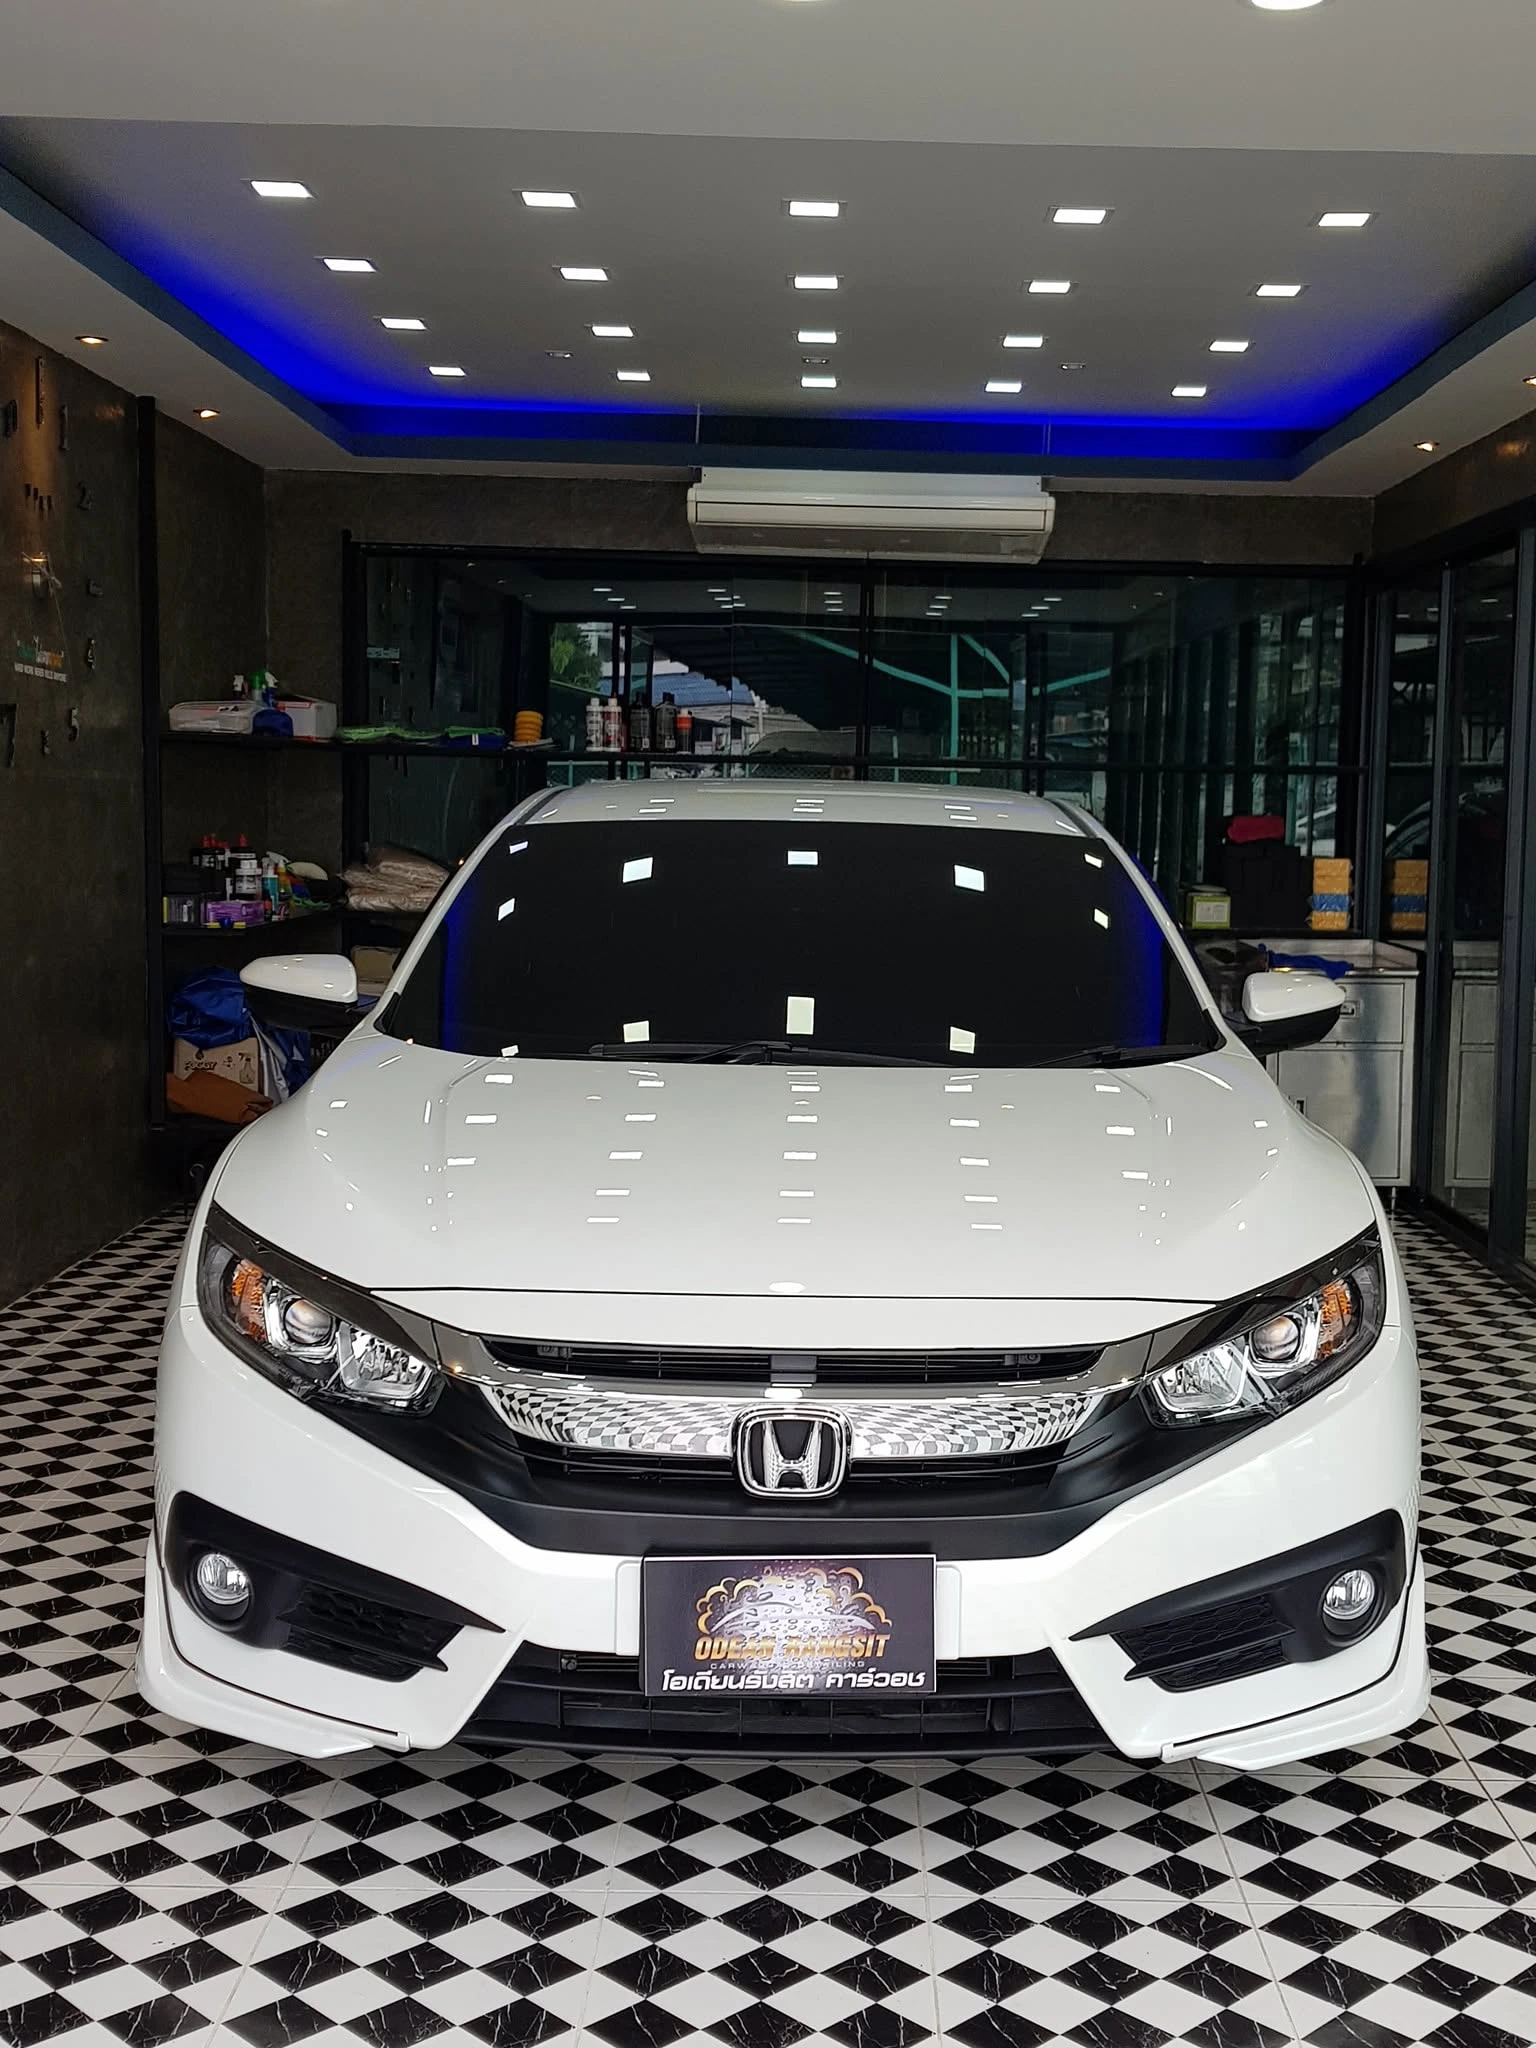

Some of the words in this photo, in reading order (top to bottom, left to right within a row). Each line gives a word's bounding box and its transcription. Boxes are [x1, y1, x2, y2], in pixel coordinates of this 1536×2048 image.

[694, 1635, 776, 1661] ODEAN
[784, 1633, 890, 1658] RANGSIT
[662, 1669, 815, 1691] โอเดียนรังสิต
[825, 1667, 926, 1688] คาร์วอช
